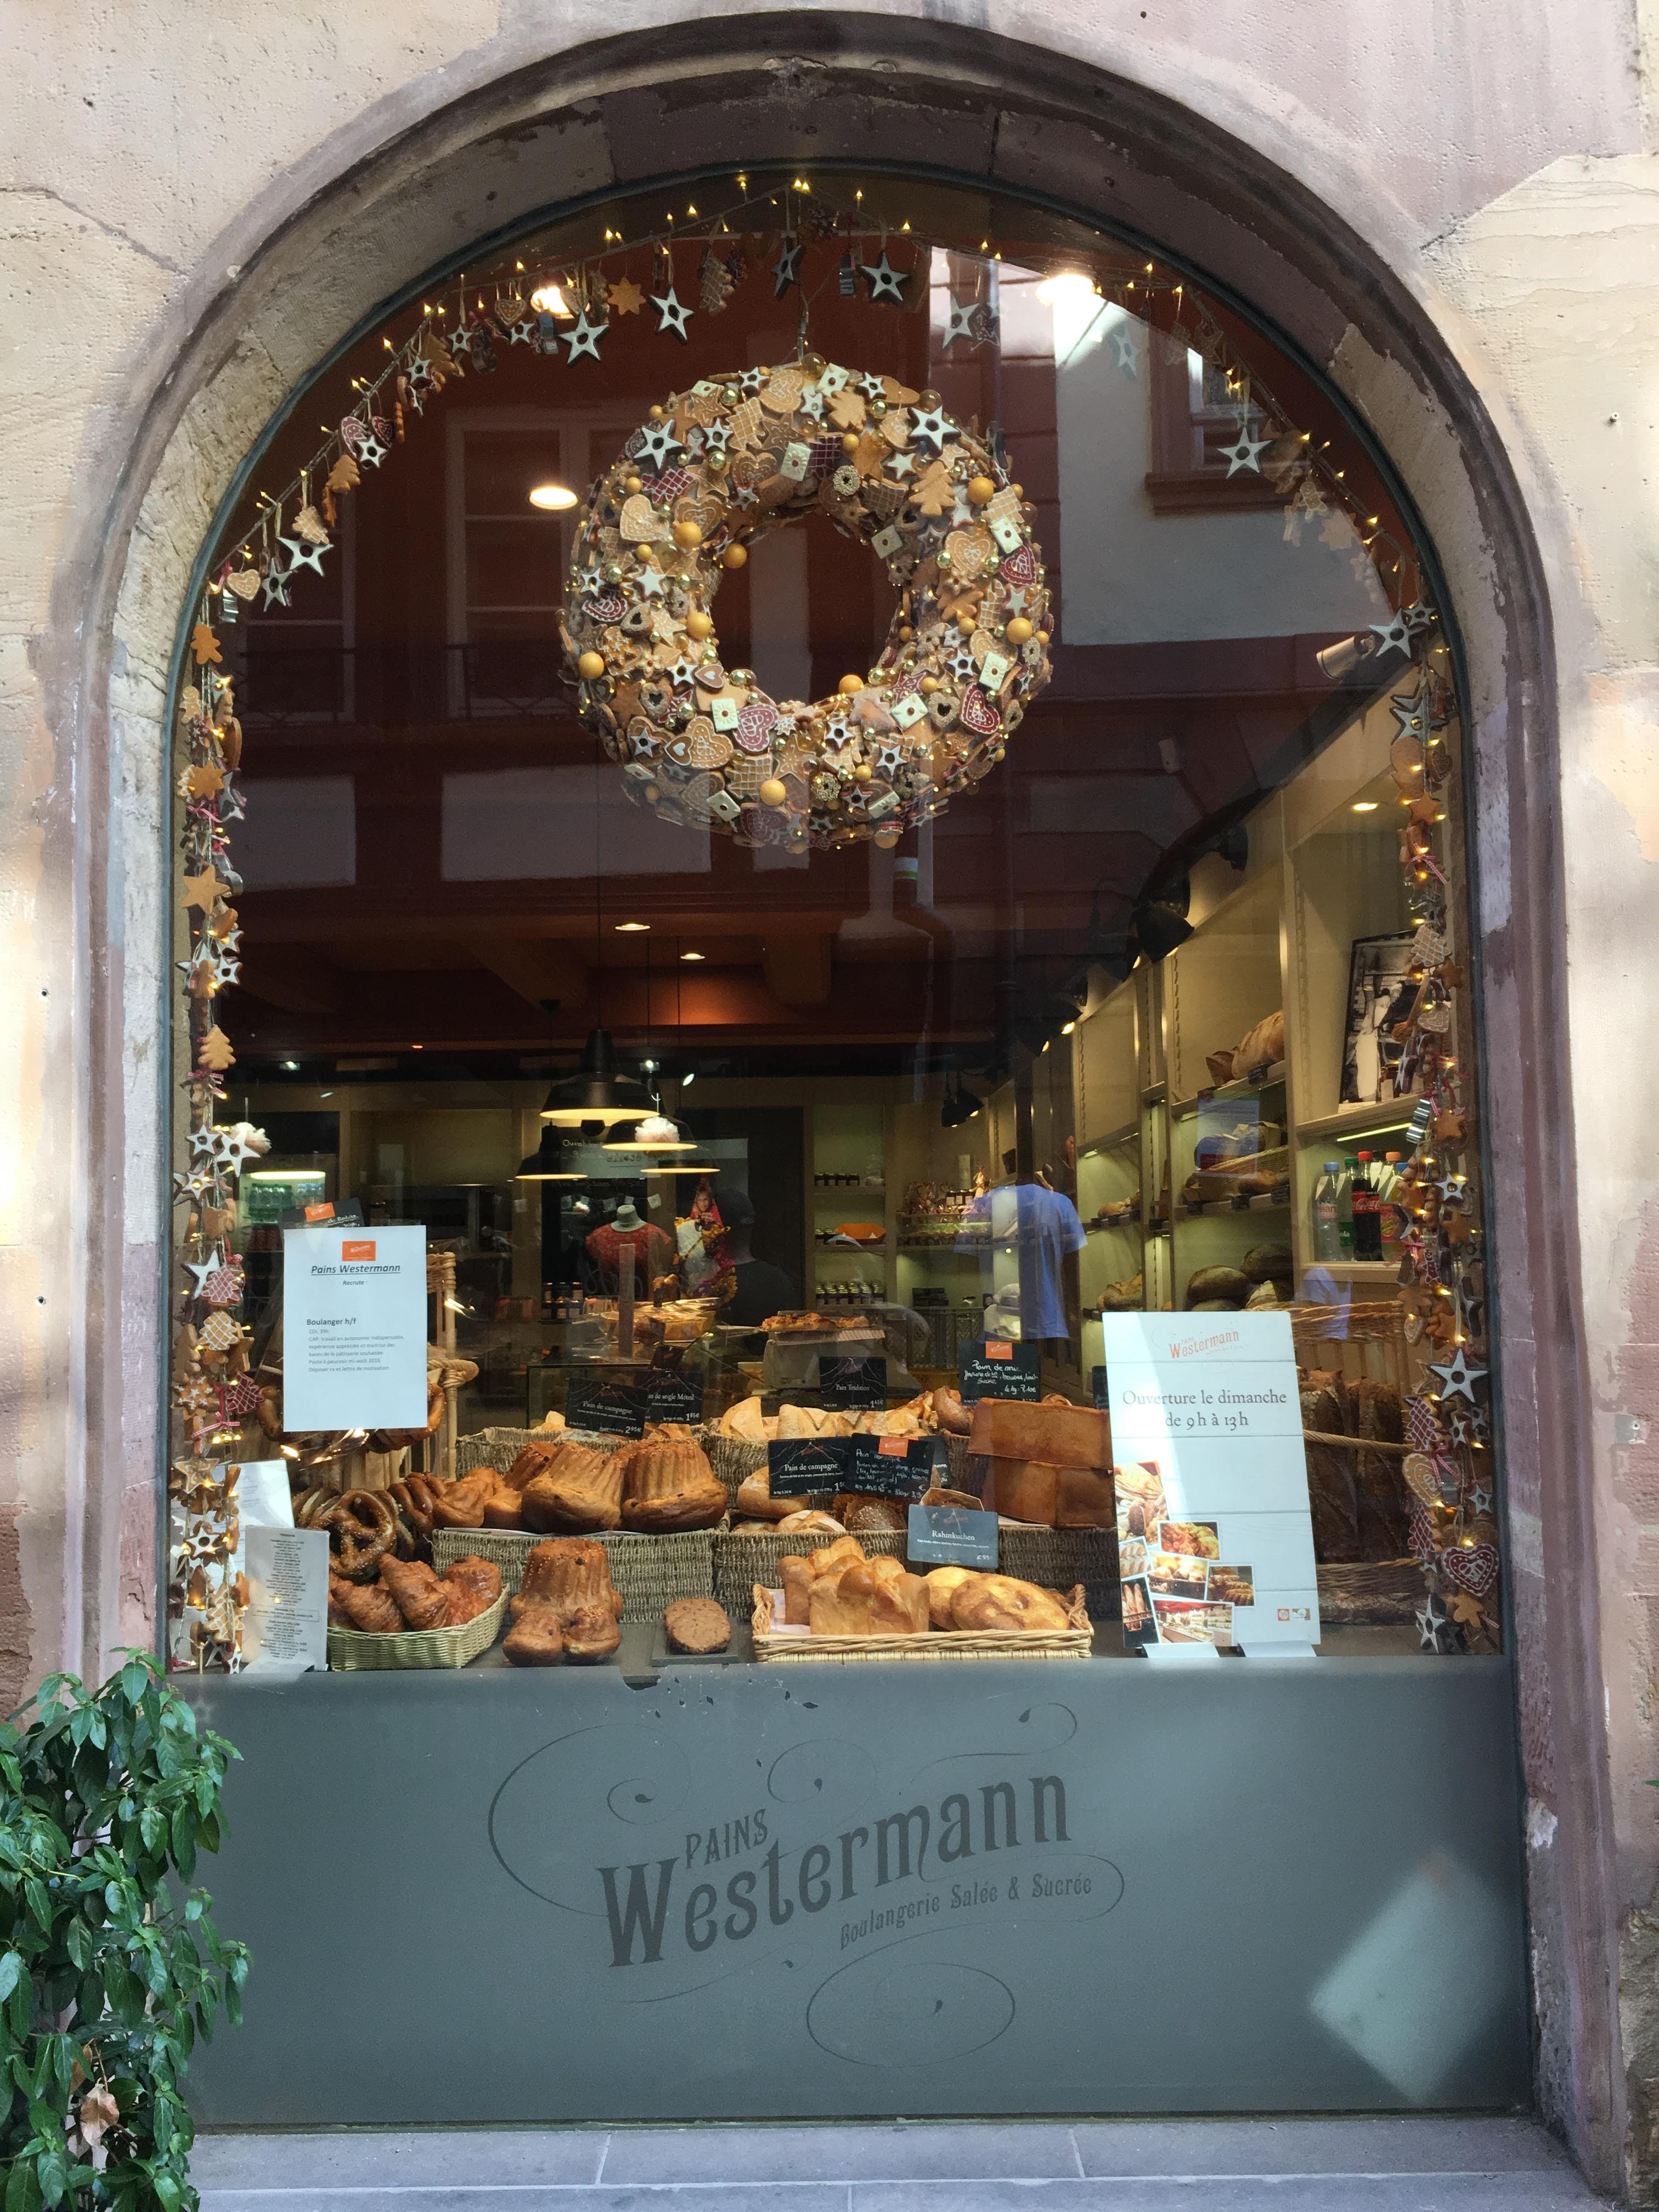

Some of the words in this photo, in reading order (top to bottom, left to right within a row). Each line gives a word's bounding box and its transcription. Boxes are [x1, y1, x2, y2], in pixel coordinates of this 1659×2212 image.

[311, 1265, 336, 1273] Pains
[340, 1265, 400, 1273] Westermann
[345, 1317, 357, 1325] h/f
[1169, 1330, 1240, 1359] Westermann
[1122, 1390, 1196, 1404] Ouverture
[1201, 1389, 1213, 1404] le
[1218, 1388, 1287, 1404] dimanche
[605, 1405, 633, 1415] campagne
[1165, 1412, 1181, 1426] de
[1211, 1413, 1219, 1426] à
[808, 1463, 838, 1472] campagne
[932, 1530, 975, 1541] Rahmkuchen
[685, 1808, 768, 1869] PAINS
[597, 1775, 1072, 1968] Westermann
[840, 1892, 940, 1950] Boulangerie
[950, 1881, 998, 1909] Salée
[1008, 1876, 1020, 1900] &
[1032, 1872, 1092, 1898] Sucrée
